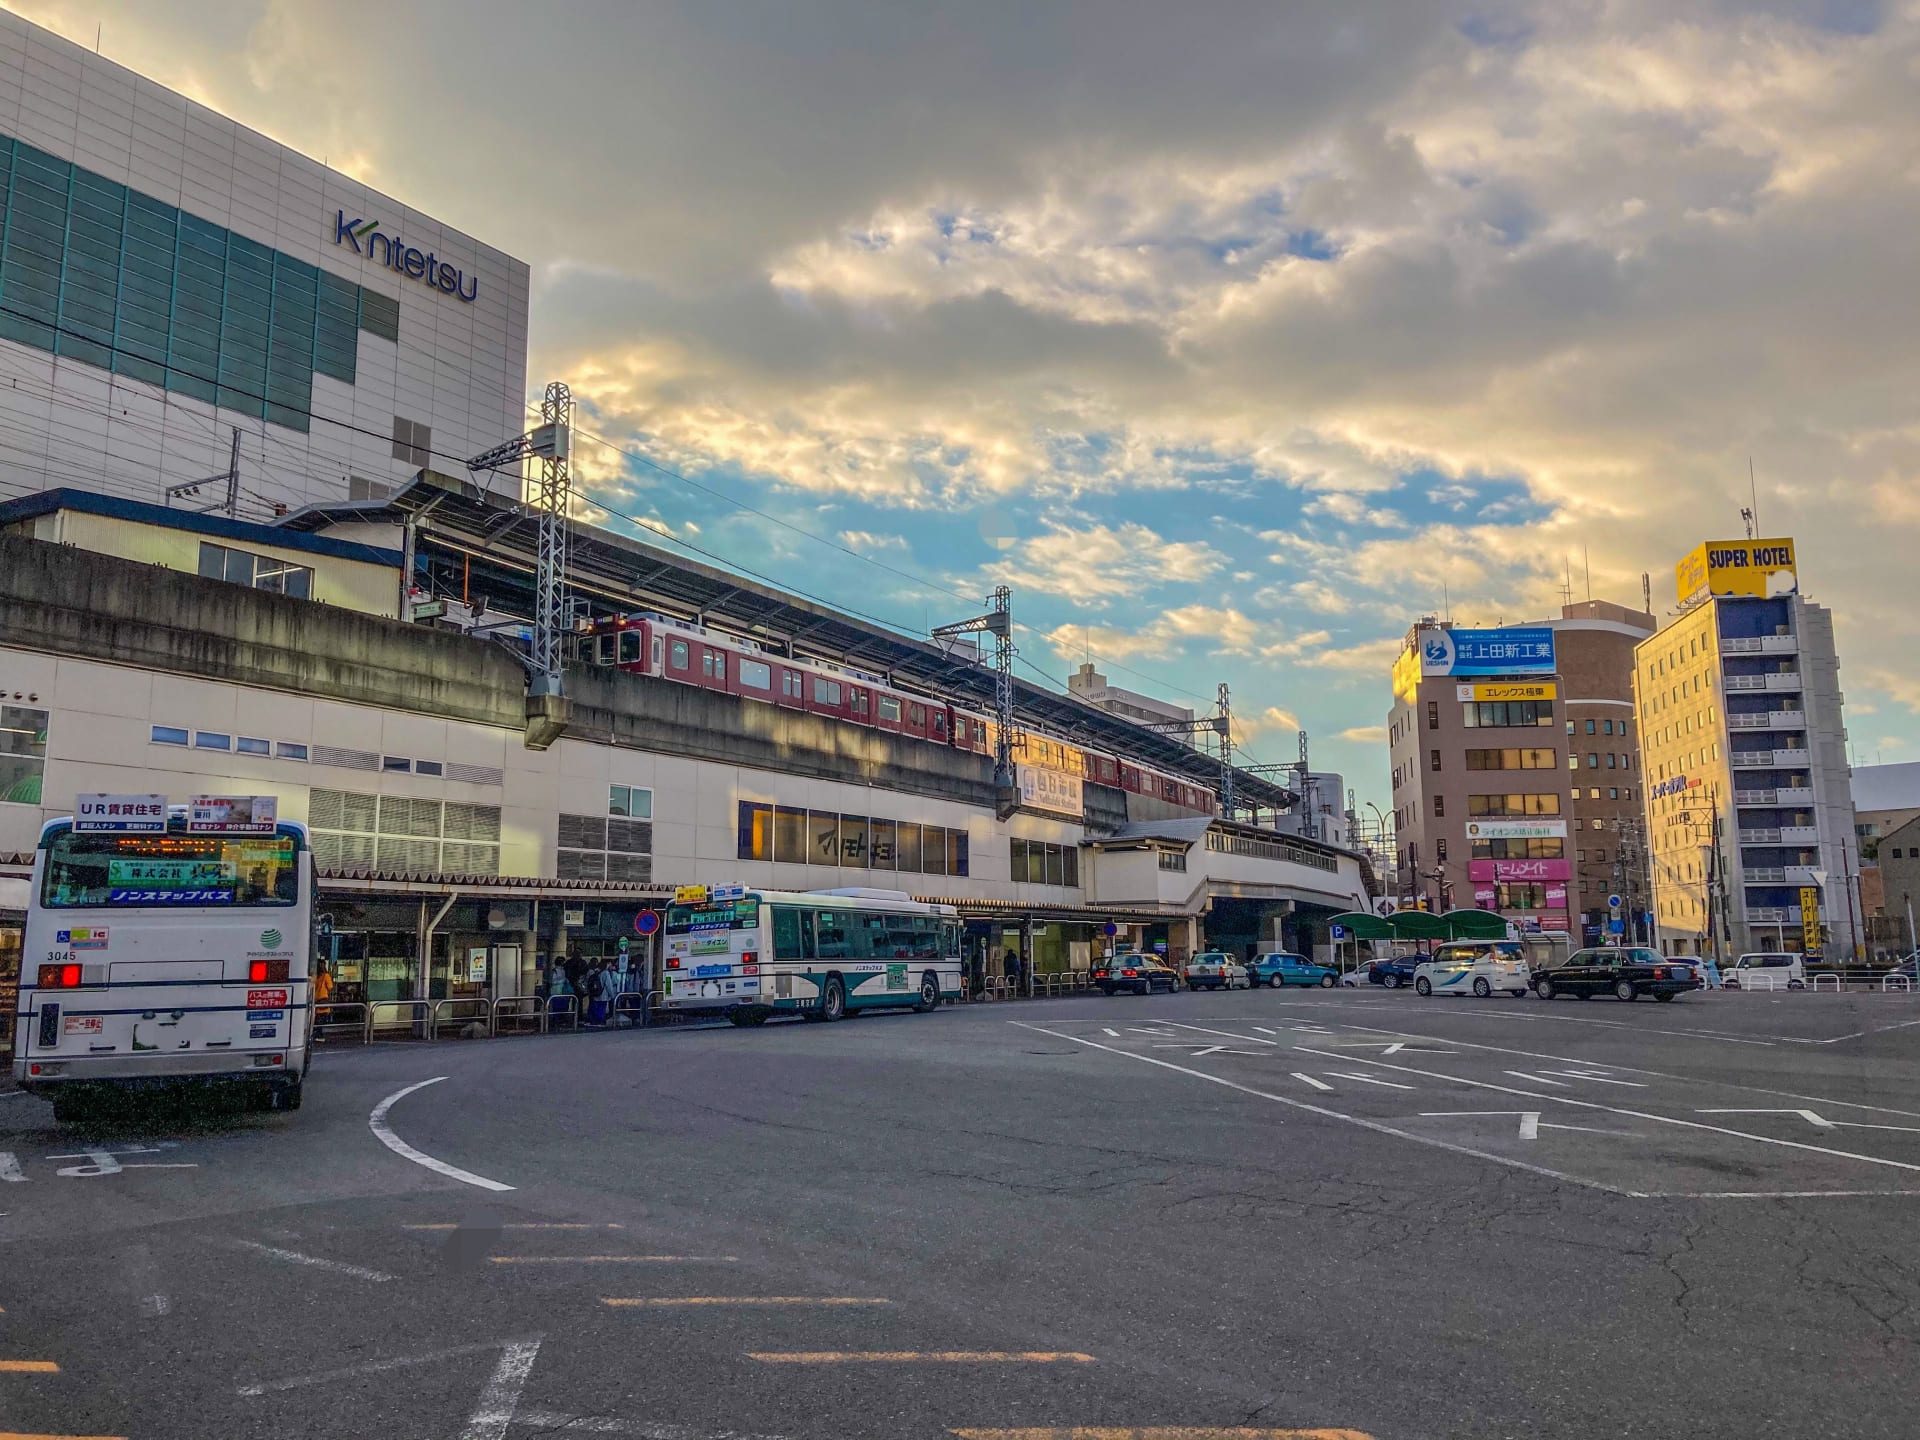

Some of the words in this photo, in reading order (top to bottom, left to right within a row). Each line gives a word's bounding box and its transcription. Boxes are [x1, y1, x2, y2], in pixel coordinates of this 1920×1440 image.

[1709, 548, 1749, 568] SUPER
[1752, 546, 1792, 566] HOTEL
[1474, 643, 1551, 659] 上田新工業
[131, 867, 181, 878] 株式会社
[113, 891, 231, 901] ノンステップバス
[691, 922, 730, 931] ノンステップバス
[1335, 927, 1342, 938] P
[47, 951, 77, 961] 3045
